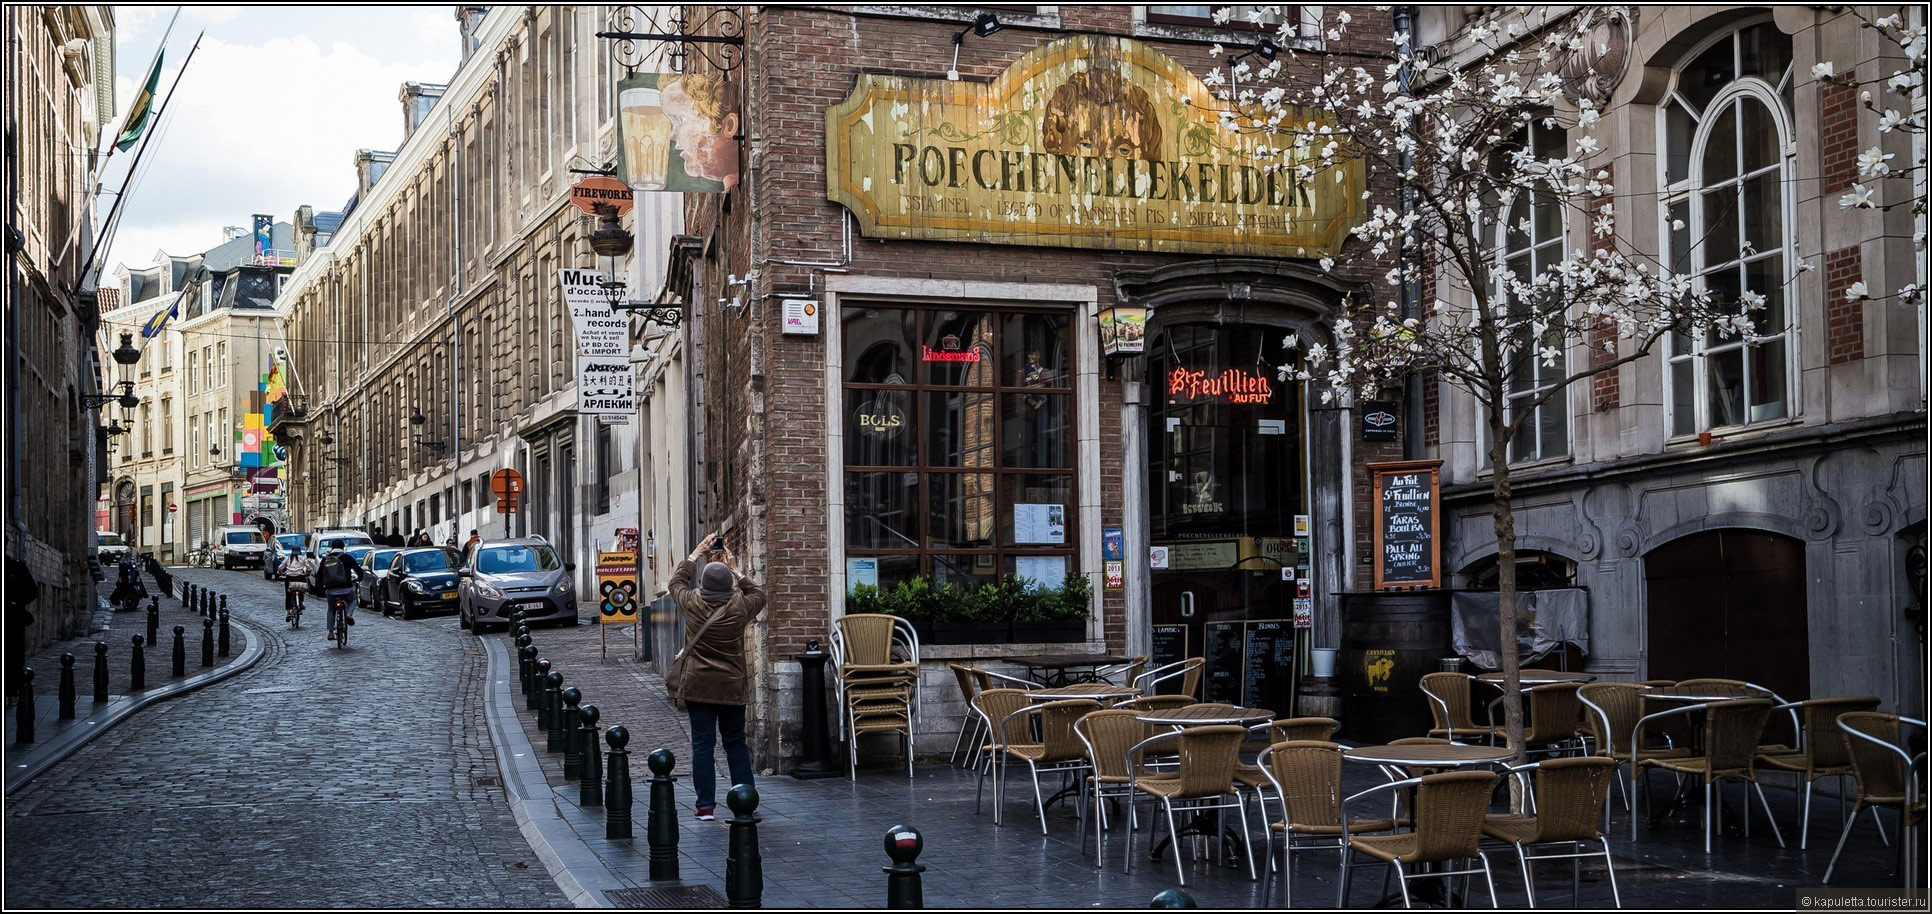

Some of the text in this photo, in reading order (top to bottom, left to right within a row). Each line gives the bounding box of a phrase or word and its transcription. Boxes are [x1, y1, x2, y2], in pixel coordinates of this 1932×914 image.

[892, 143, 1311, 208] POECHENELLEKELDER
[573, 187, 633, 200] FIREWORKS
[905, 195, 969, 213] ESTAMINET
[997, 200, 1043, 217] LEGEND
[1050, 203, 1064, 218] OF
[1072, 206, 1136, 224] MANNEKEN
[1146, 208, 1165, 224] PIS
[1190, 211, 1229, 227] BIERES
[567, 287, 626, 296] d'occasion
[585, 308, 610, 318] hand
[587, 320, 627, 328] records
[1190, 369, 1269, 400] Feuillien
[1234, 393, 1269, 403] AU FUT
[583, 400, 632, 409] АРЛЕКИН
[860, 414, 900, 426] BOLS
[1392, 476, 1404, 486] Au
[1390, 515, 1419, 525] TARAS
[1389, 524, 1424, 532] BOULBA
[1388, 553, 1420, 562] SPRING
